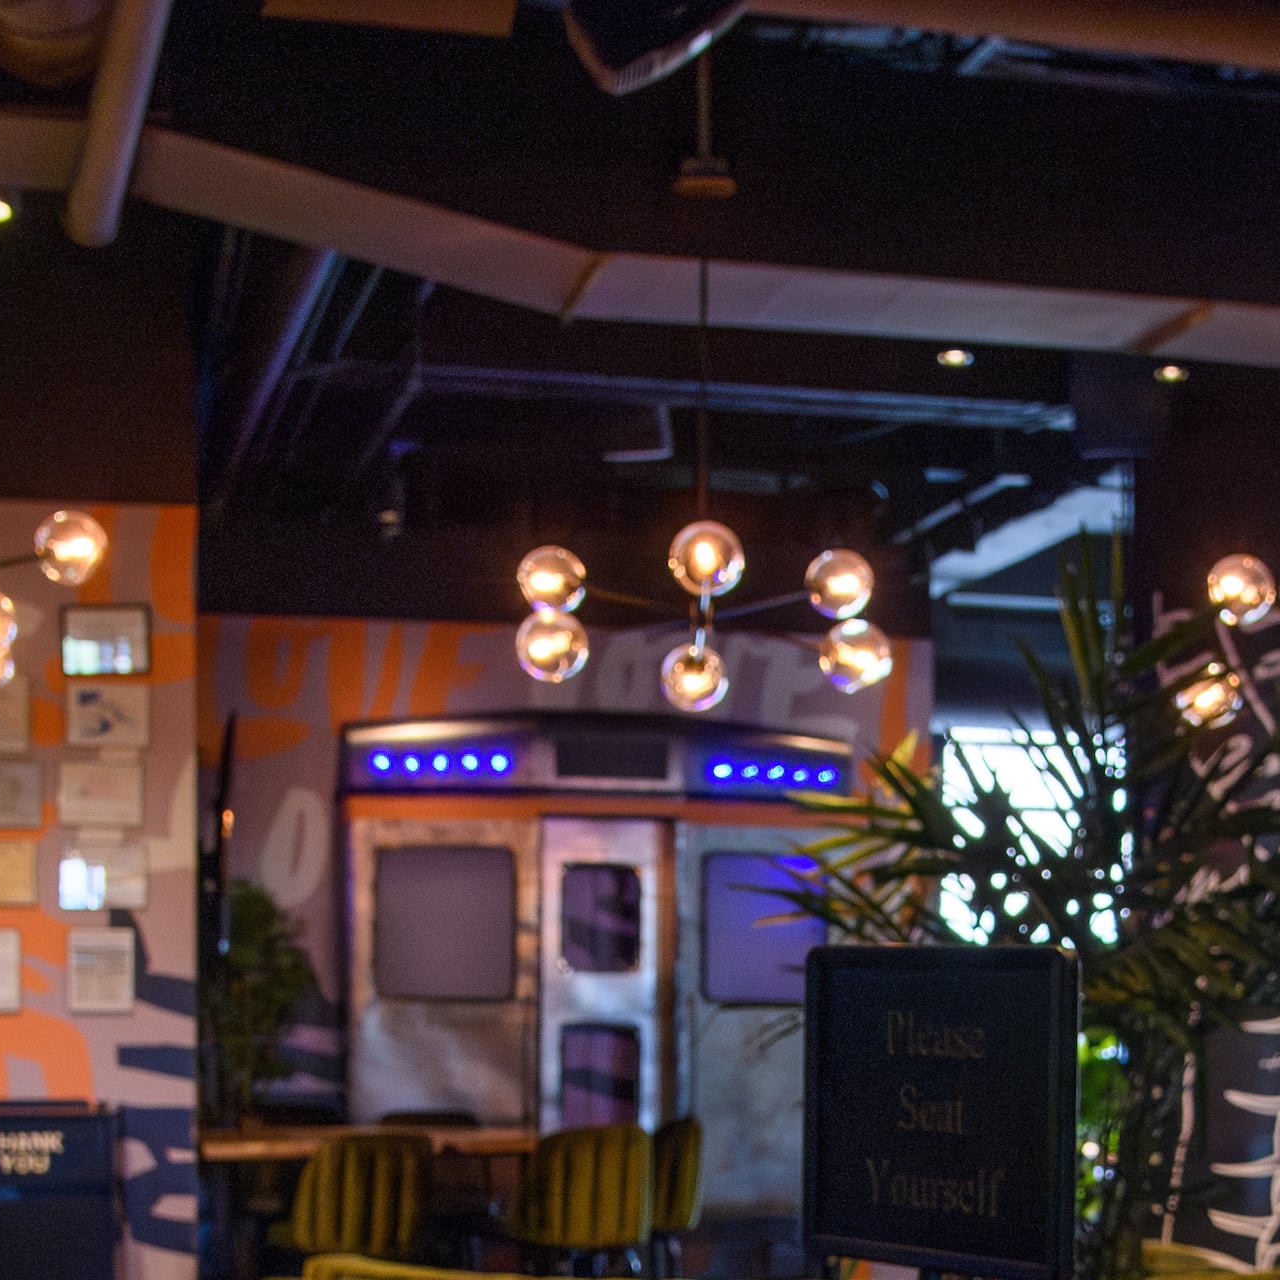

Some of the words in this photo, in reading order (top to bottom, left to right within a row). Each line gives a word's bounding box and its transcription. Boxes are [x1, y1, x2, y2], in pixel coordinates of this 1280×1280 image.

[885, 1009, 987, 1060] Please
[896, 1083, 964, 1135] Seat
[864, 1158, 1007, 1218] Yourself
